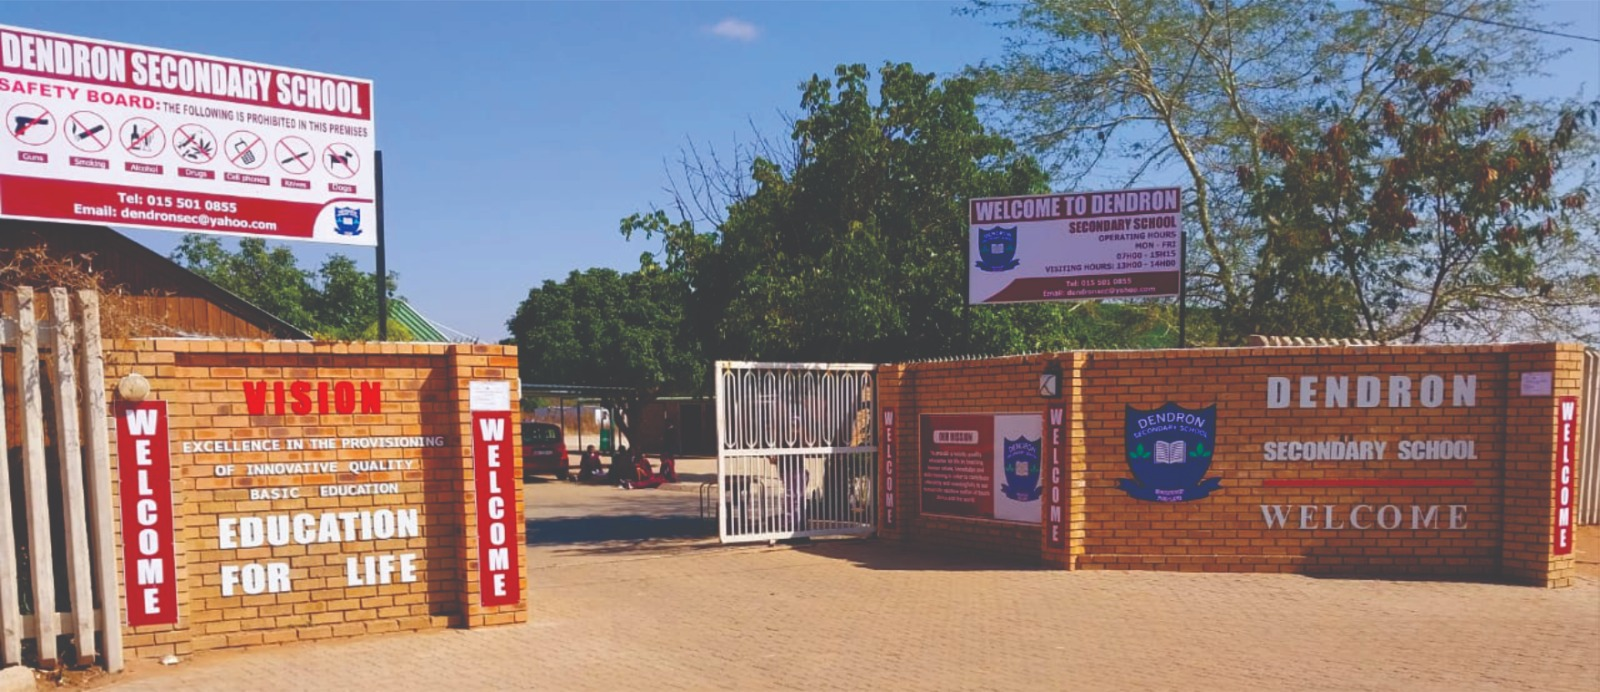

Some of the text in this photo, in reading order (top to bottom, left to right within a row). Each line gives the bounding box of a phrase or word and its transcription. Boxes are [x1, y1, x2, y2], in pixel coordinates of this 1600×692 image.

[1, 31, 363, 115] DENDRON SECONDARY SCHOOL
[0, 77, 161, 110] SAFETY BOARD:
[163, 102, 368, 137] THE FOLLOWING IS PROHIBITED IN THIS PREMISES
[22, 152, 44, 162] Guns
[74, 157, 106, 169] Smoking
[130, 163, 159, 174] Alcohol
[185, 168, 208, 179] Drugs
[226, 172, 268, 185] Cell phones
[332, 184, 352, 193] Dogs
[117, 192, 237, 213] Tel: 015 501 0855
[976, 190, 1177, 221] WELCOME TO DENDRON
[73, 203, 277, 231] Email: dendronsec@yahoo.com
[1069, 215, 1176, 234] SECONDARY SCHOOL
[1098, 231, 1176, 242] OPERATING HOURS
[1116, 252, 1142, 260] 07H00
[1045, 264, 1082, 273] VISITING
[1084, 262, 1114, 271] HOURS:
[242, 381, 381, 416] VISION
[1267, 375, 1477, 409] DENDRON
[1138, 412, 1206, 429] DENDRON
[182, 436, 444, 453] EXCELLENCE IN THE PROVISIONING
[1263, 440, 1478, 461] SECONDARY SCHOOL
[215, 459, 413, 476] OF INNOVATIVE QUALITY
[884, 411, 894, 524] WELCOME
[1050, 408, 1063, 542] WELCOME
[1559, 402, 1575, 548] WELCOME
[250, 483, 399, 501] BASIC EDUCATION
[126, 409, 164, 615] WELCOME
[479, 418, 511, 597] WELCOME
[1260, 504, 1468, 530] WELCOME
[218, 508, 418, 549] EDUCATION
[221, 553, 417, 597] FOR LIFE
